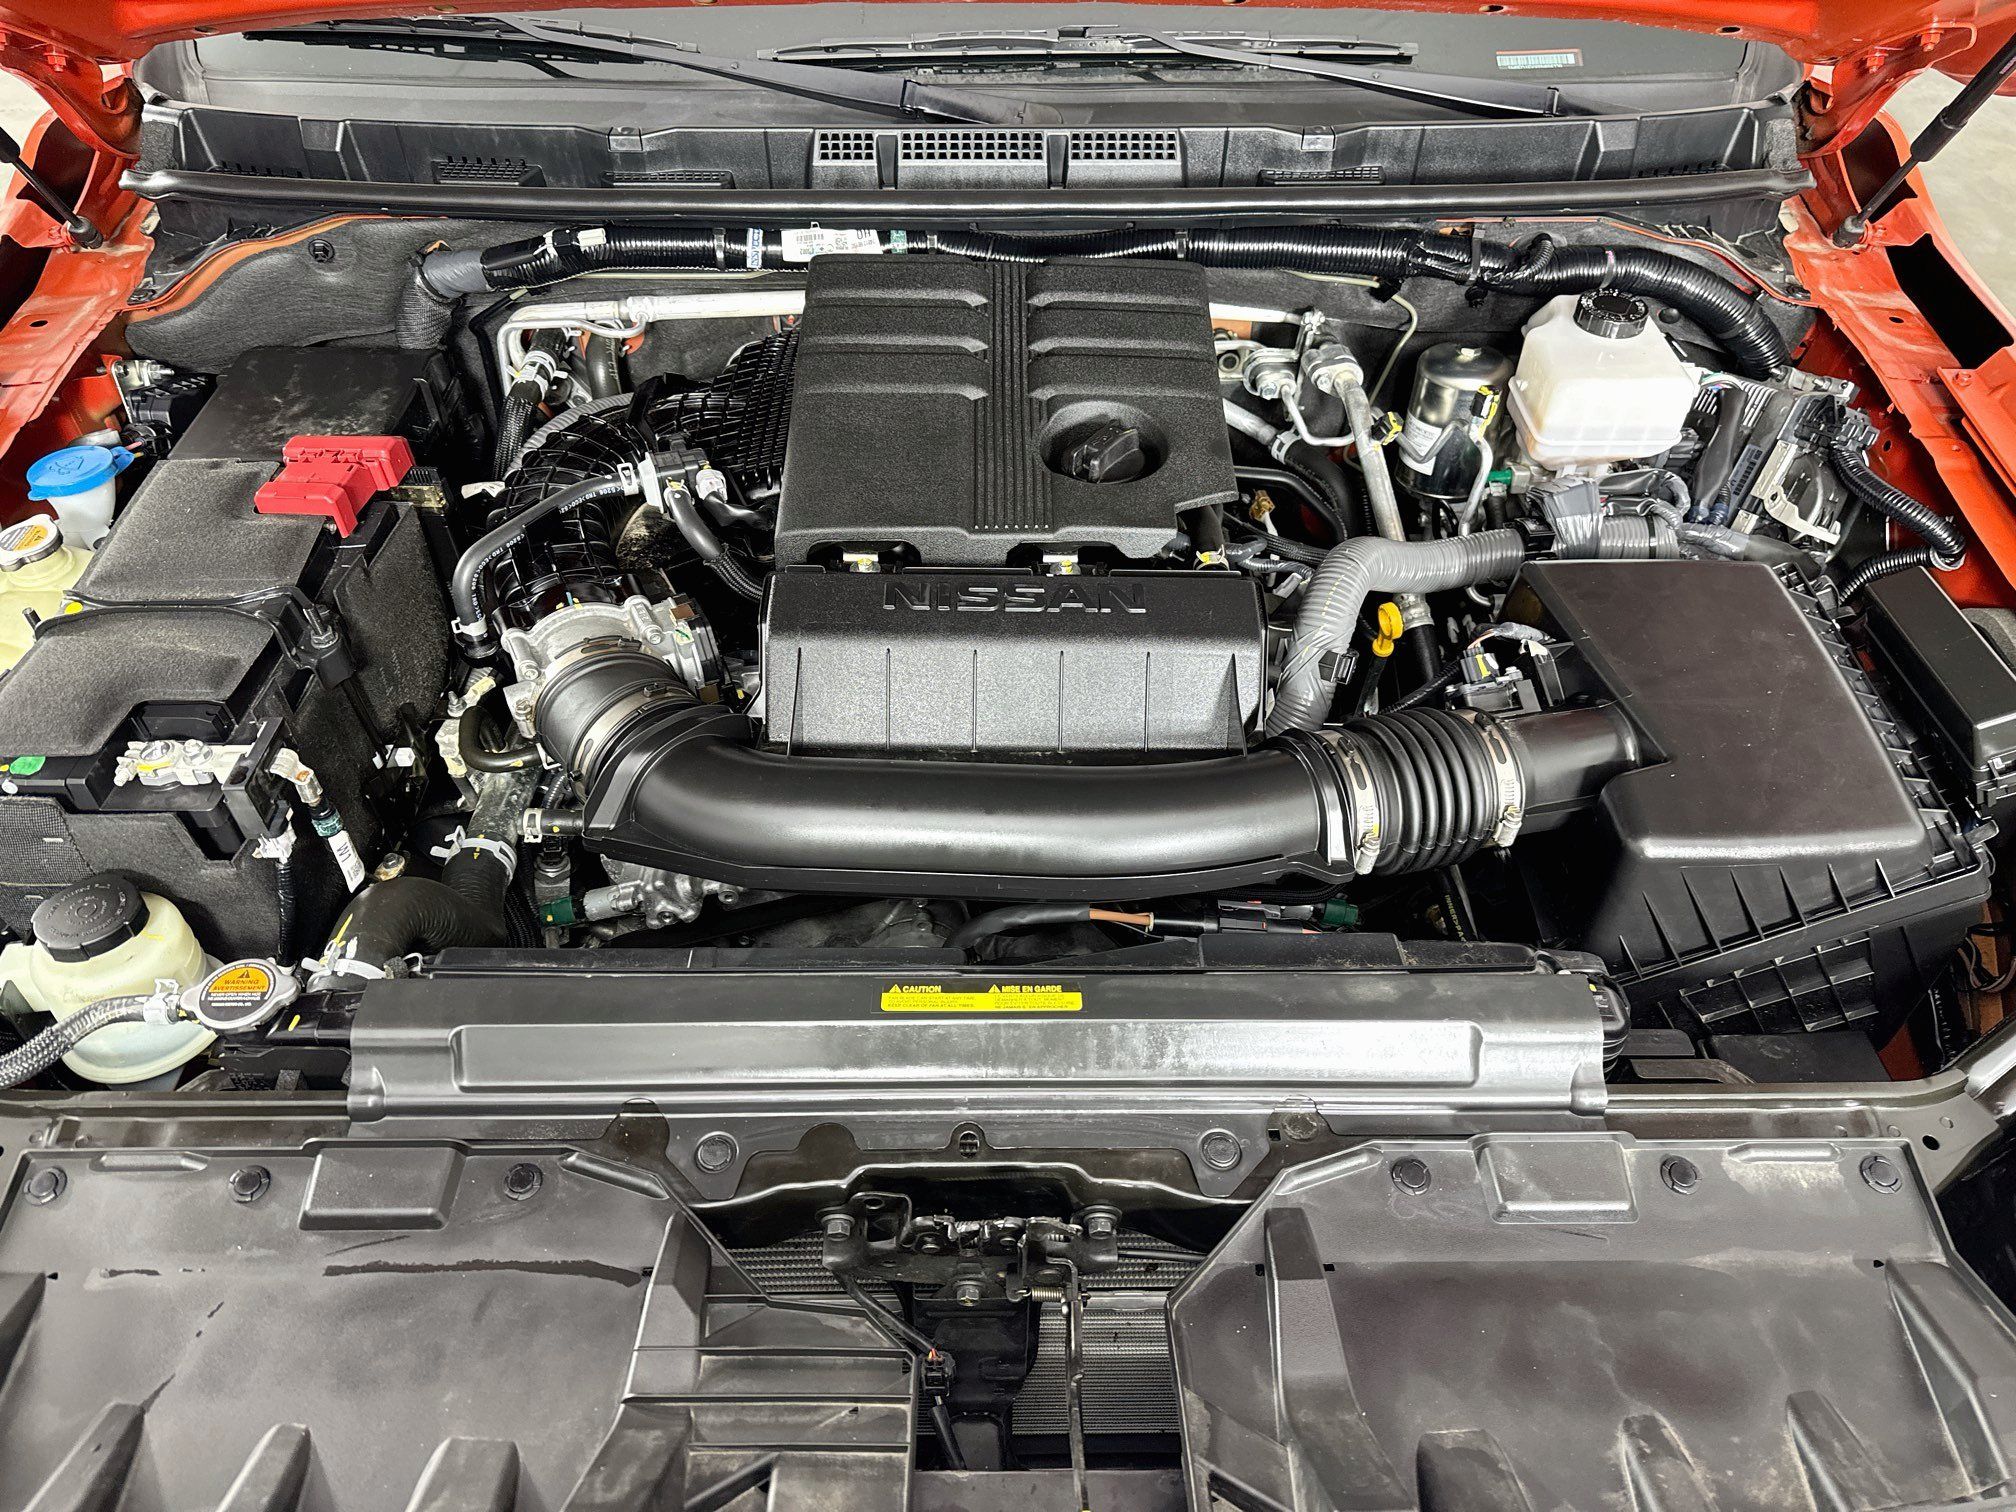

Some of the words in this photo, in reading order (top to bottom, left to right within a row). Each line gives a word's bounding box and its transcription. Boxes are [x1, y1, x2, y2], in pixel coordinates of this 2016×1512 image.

[882, 582, 1147, 613] NISSAN
[902, 985, 942, 993] CAUTION
[1001, 985, 1021, 993] MISE
[1021, 985, 1033, 993] EN
[1034, 985, 1063, 993] GARDE
